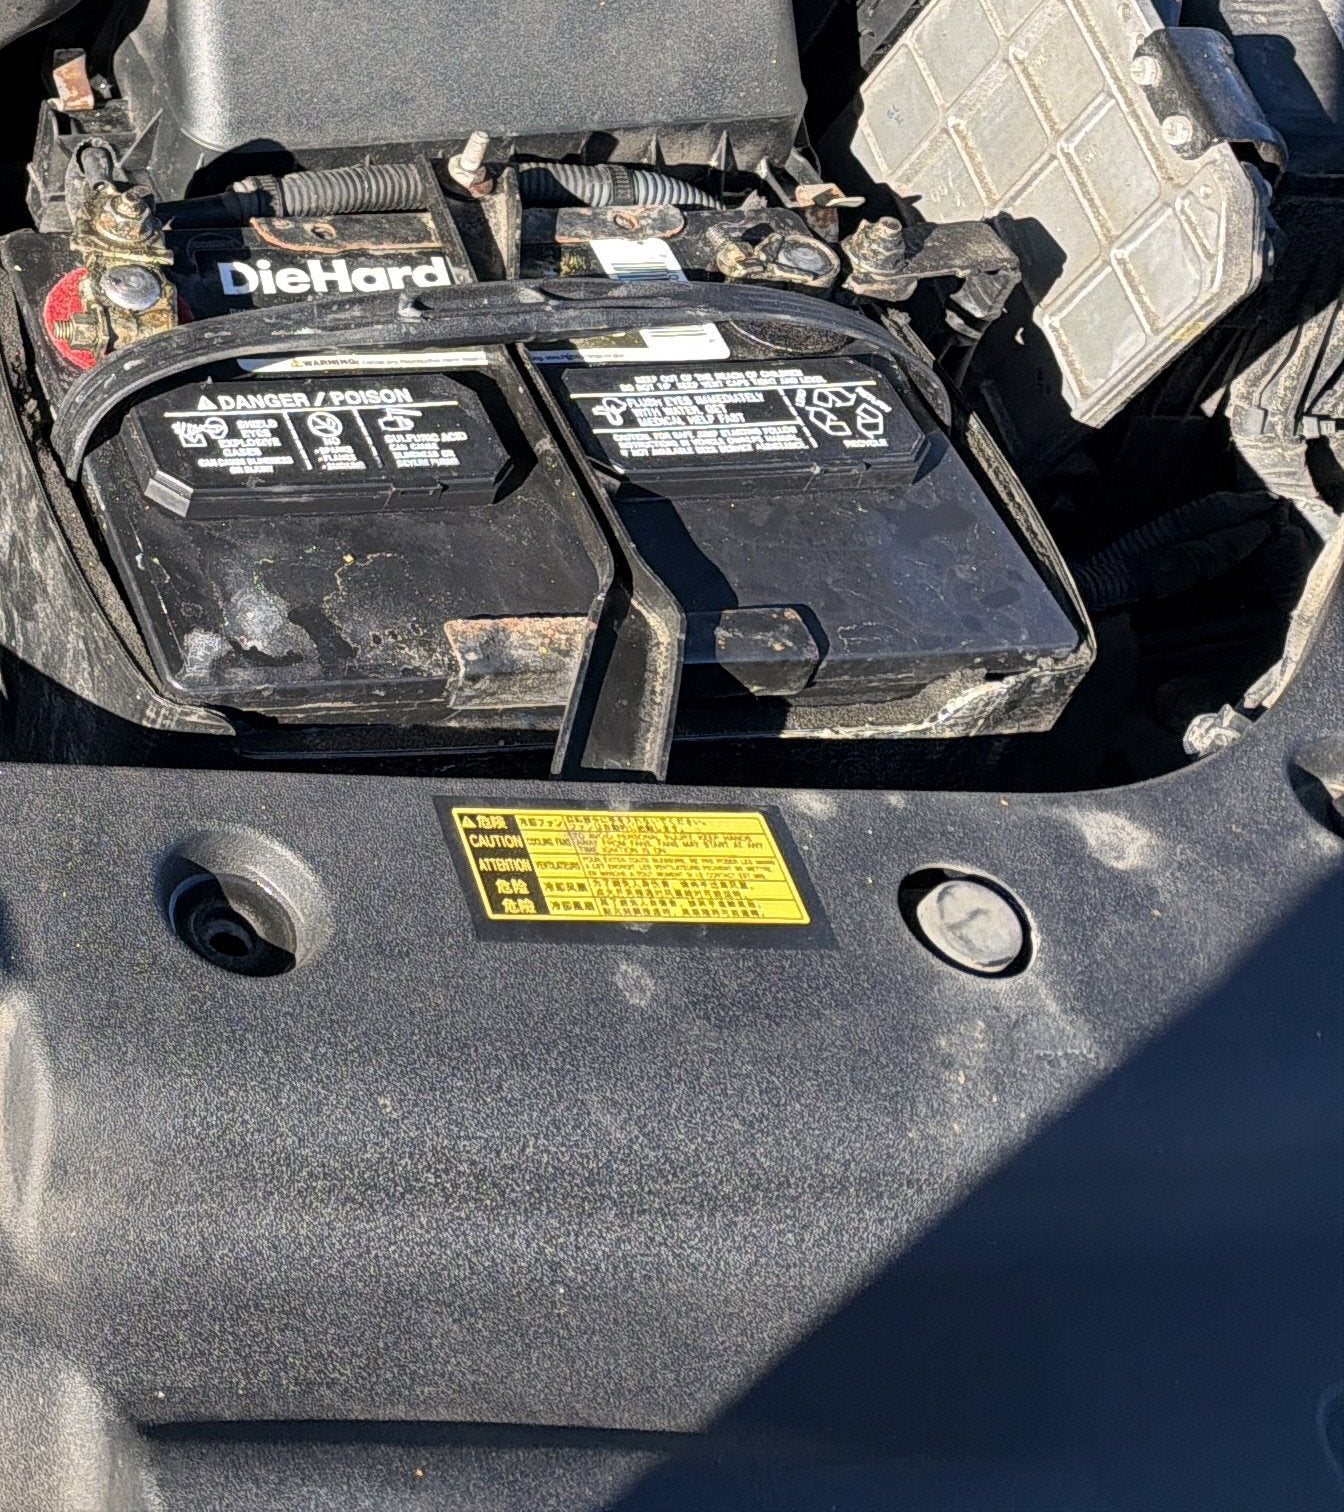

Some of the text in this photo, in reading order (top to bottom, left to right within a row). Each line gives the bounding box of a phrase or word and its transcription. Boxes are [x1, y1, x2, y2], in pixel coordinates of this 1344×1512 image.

[216, 256, 452, 296] DieHard
[217, 392, 309, 411] DANGER
[329, 388, 413, 406] POISON
[626, 392, 765, 409] FLUSH EYES IMMEDIATELY
[630, 407, 663, 418] WITH
[704, 403, 728, 415] GET
[637, 412, 746, 427] MEDICAL HELP FAST
[218, 437, 282, 448] EXPLOSIVE
[441, 431, 468, 442] ACID
[469, 834, 524, 848] CAUTION
[478, 858, 532, 872] ATTENTION
